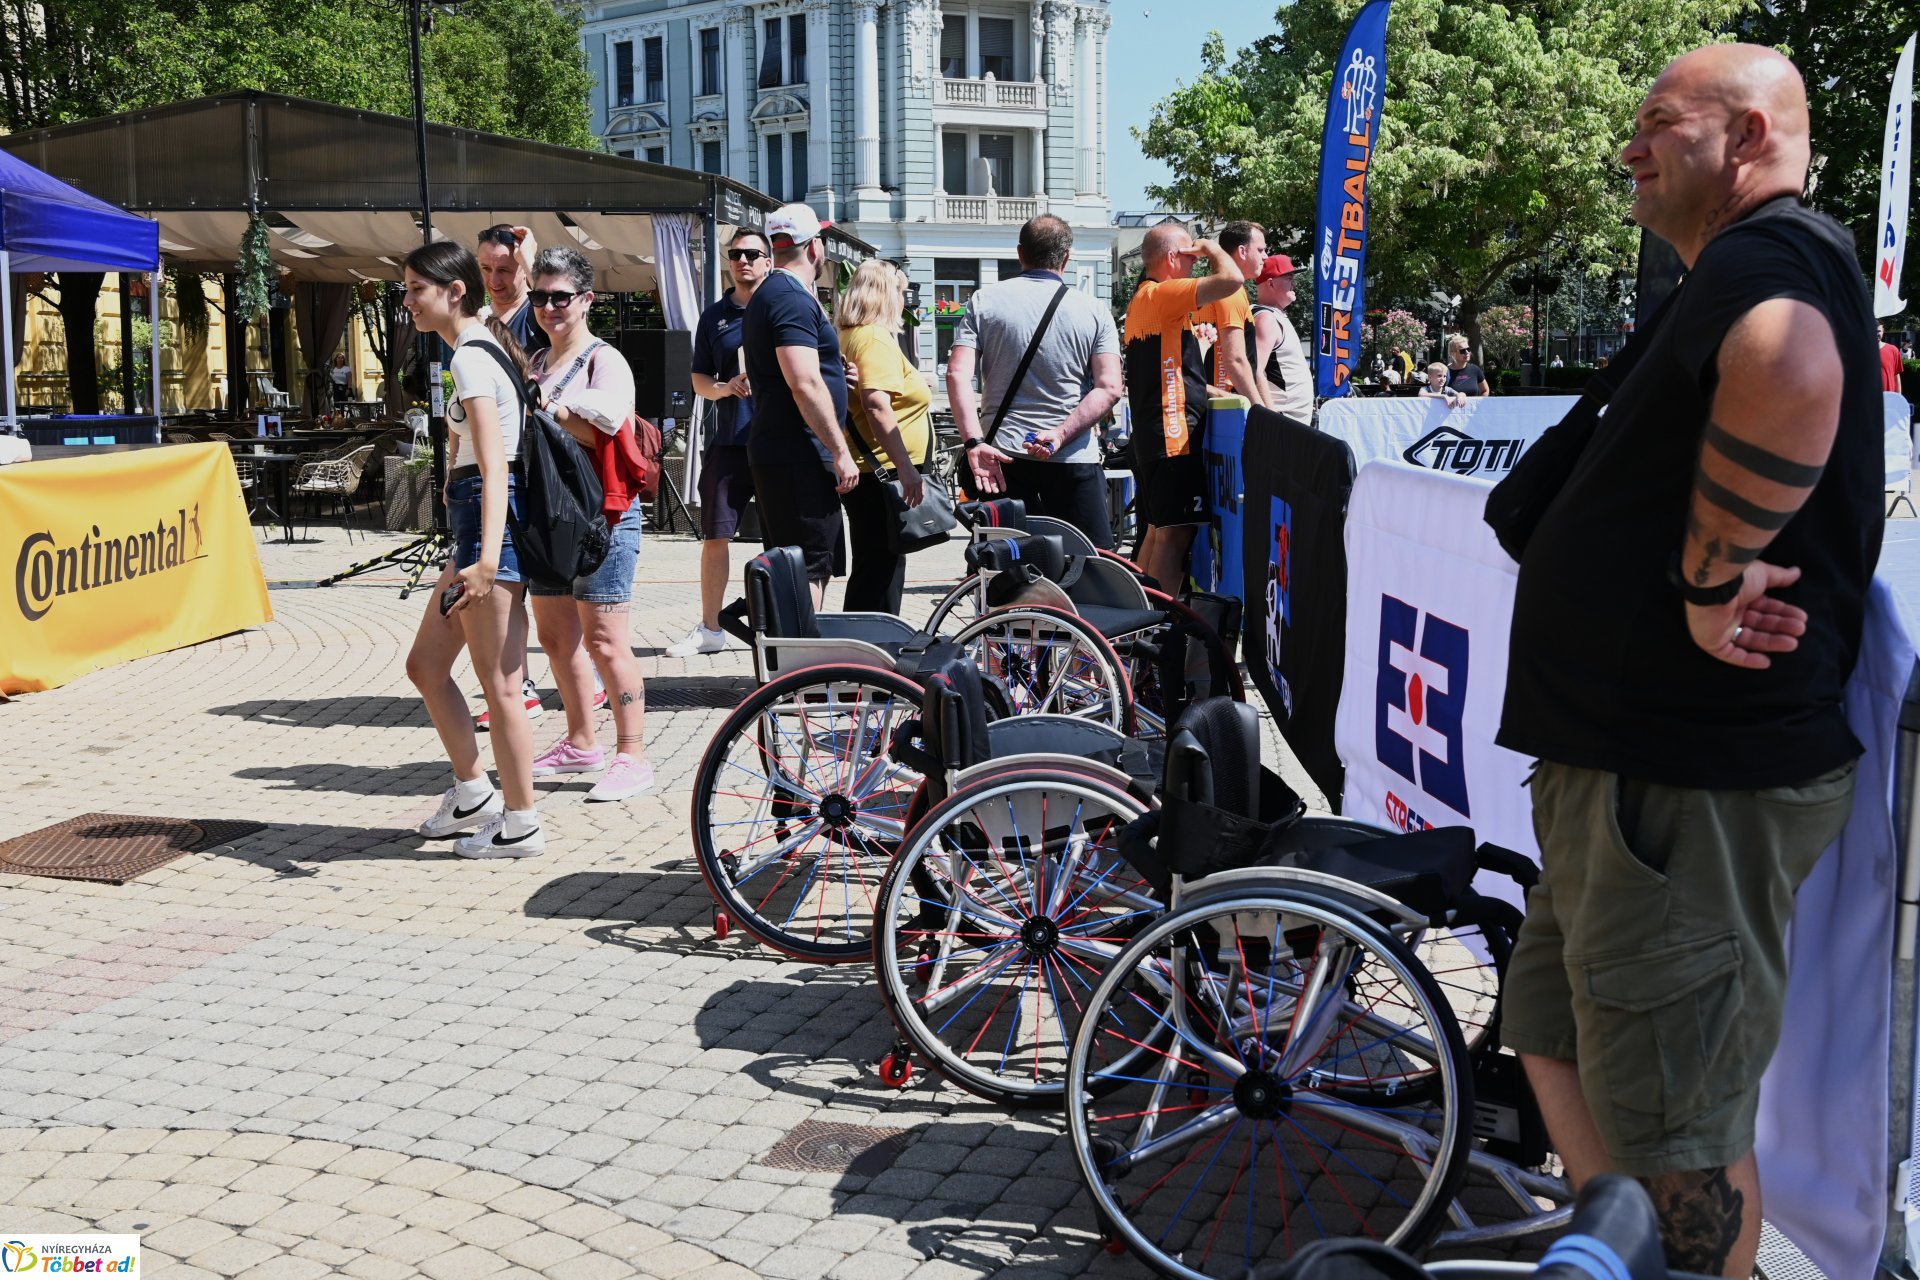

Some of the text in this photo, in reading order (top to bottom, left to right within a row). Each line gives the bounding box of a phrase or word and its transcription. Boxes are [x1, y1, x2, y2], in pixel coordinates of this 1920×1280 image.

[1332, 121, 1371, 388] STREETBALL
[1163, 368, 1182, 438] Continental
[1193, 496, 1203, 512] 2
[15, 509, 186, 622] Continental
